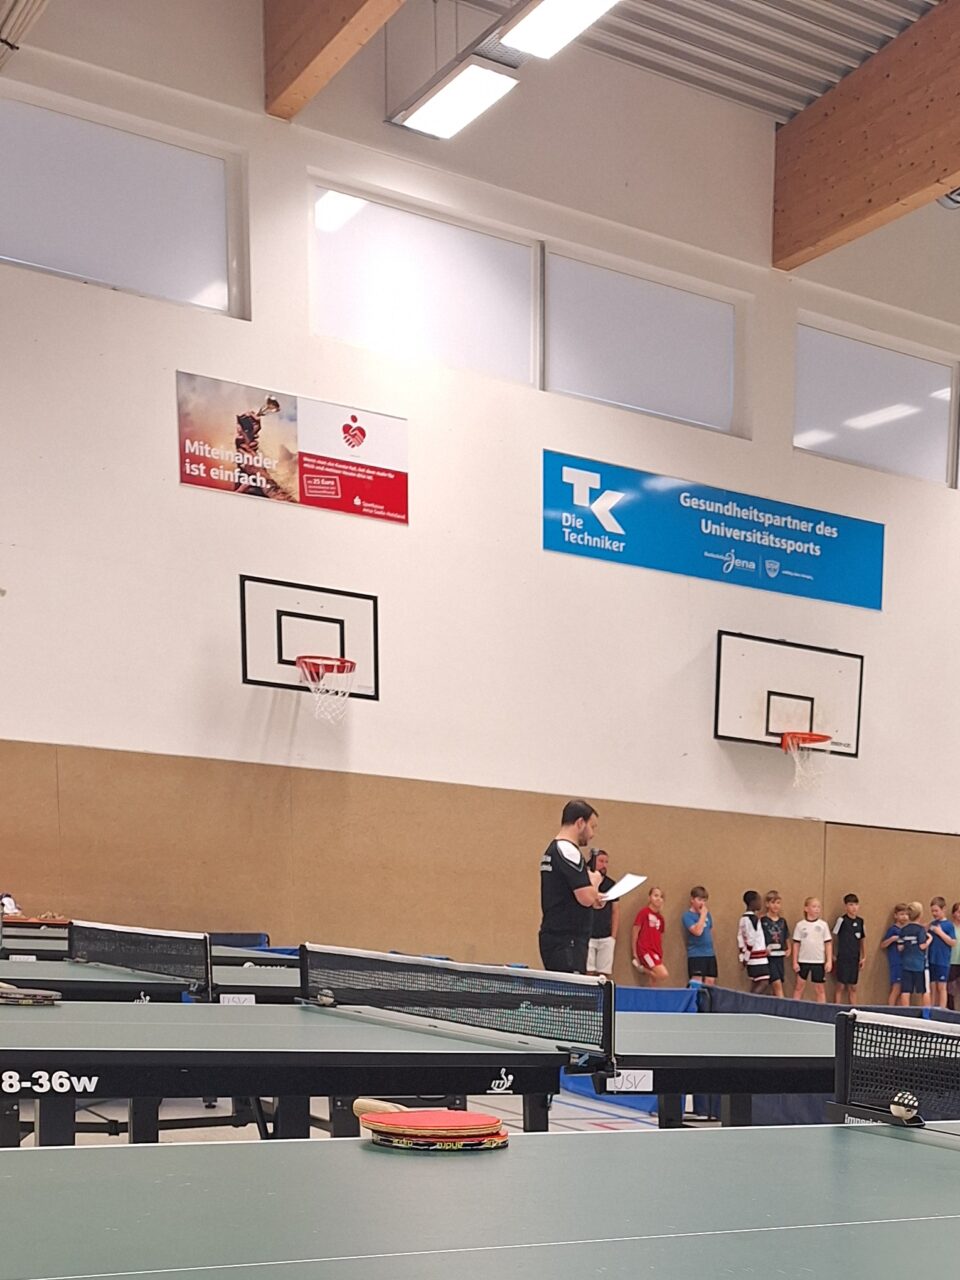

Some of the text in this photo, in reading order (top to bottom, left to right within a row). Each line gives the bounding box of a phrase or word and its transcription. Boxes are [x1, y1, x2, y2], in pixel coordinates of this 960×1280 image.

[185, 439, 278, 470] Miteinander
[185, 459, 271, 489] ist einfach.
[562, 466, 625, 535] TK
[679, 492, 838, 539] Gesundheitspartner des
[562, 512, 584, 529] Die
[562, 528, 625, 552] Techniker
[701, 519, 821, 557] Universitätssports
[1, 1070, 99, 1093] 8-36w
